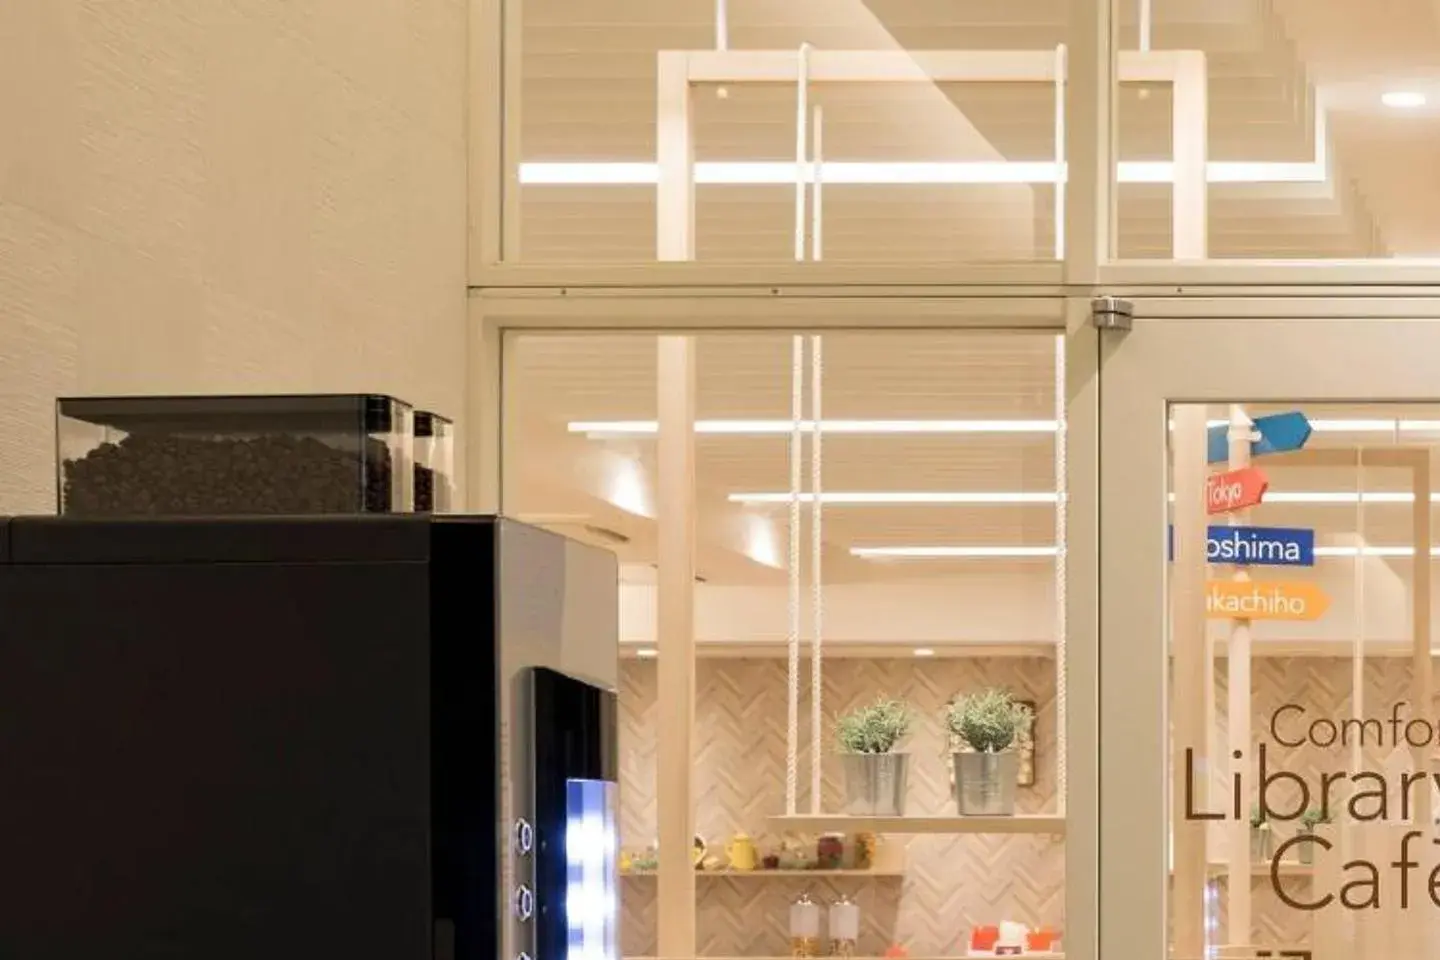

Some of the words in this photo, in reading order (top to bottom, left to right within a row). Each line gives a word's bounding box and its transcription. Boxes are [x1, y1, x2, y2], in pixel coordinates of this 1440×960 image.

[1207, 480, 1243, 508] Tokyo
[1206, 530, 1300, 561] oshima
[1207, 585, 1306, 615] kachiho
